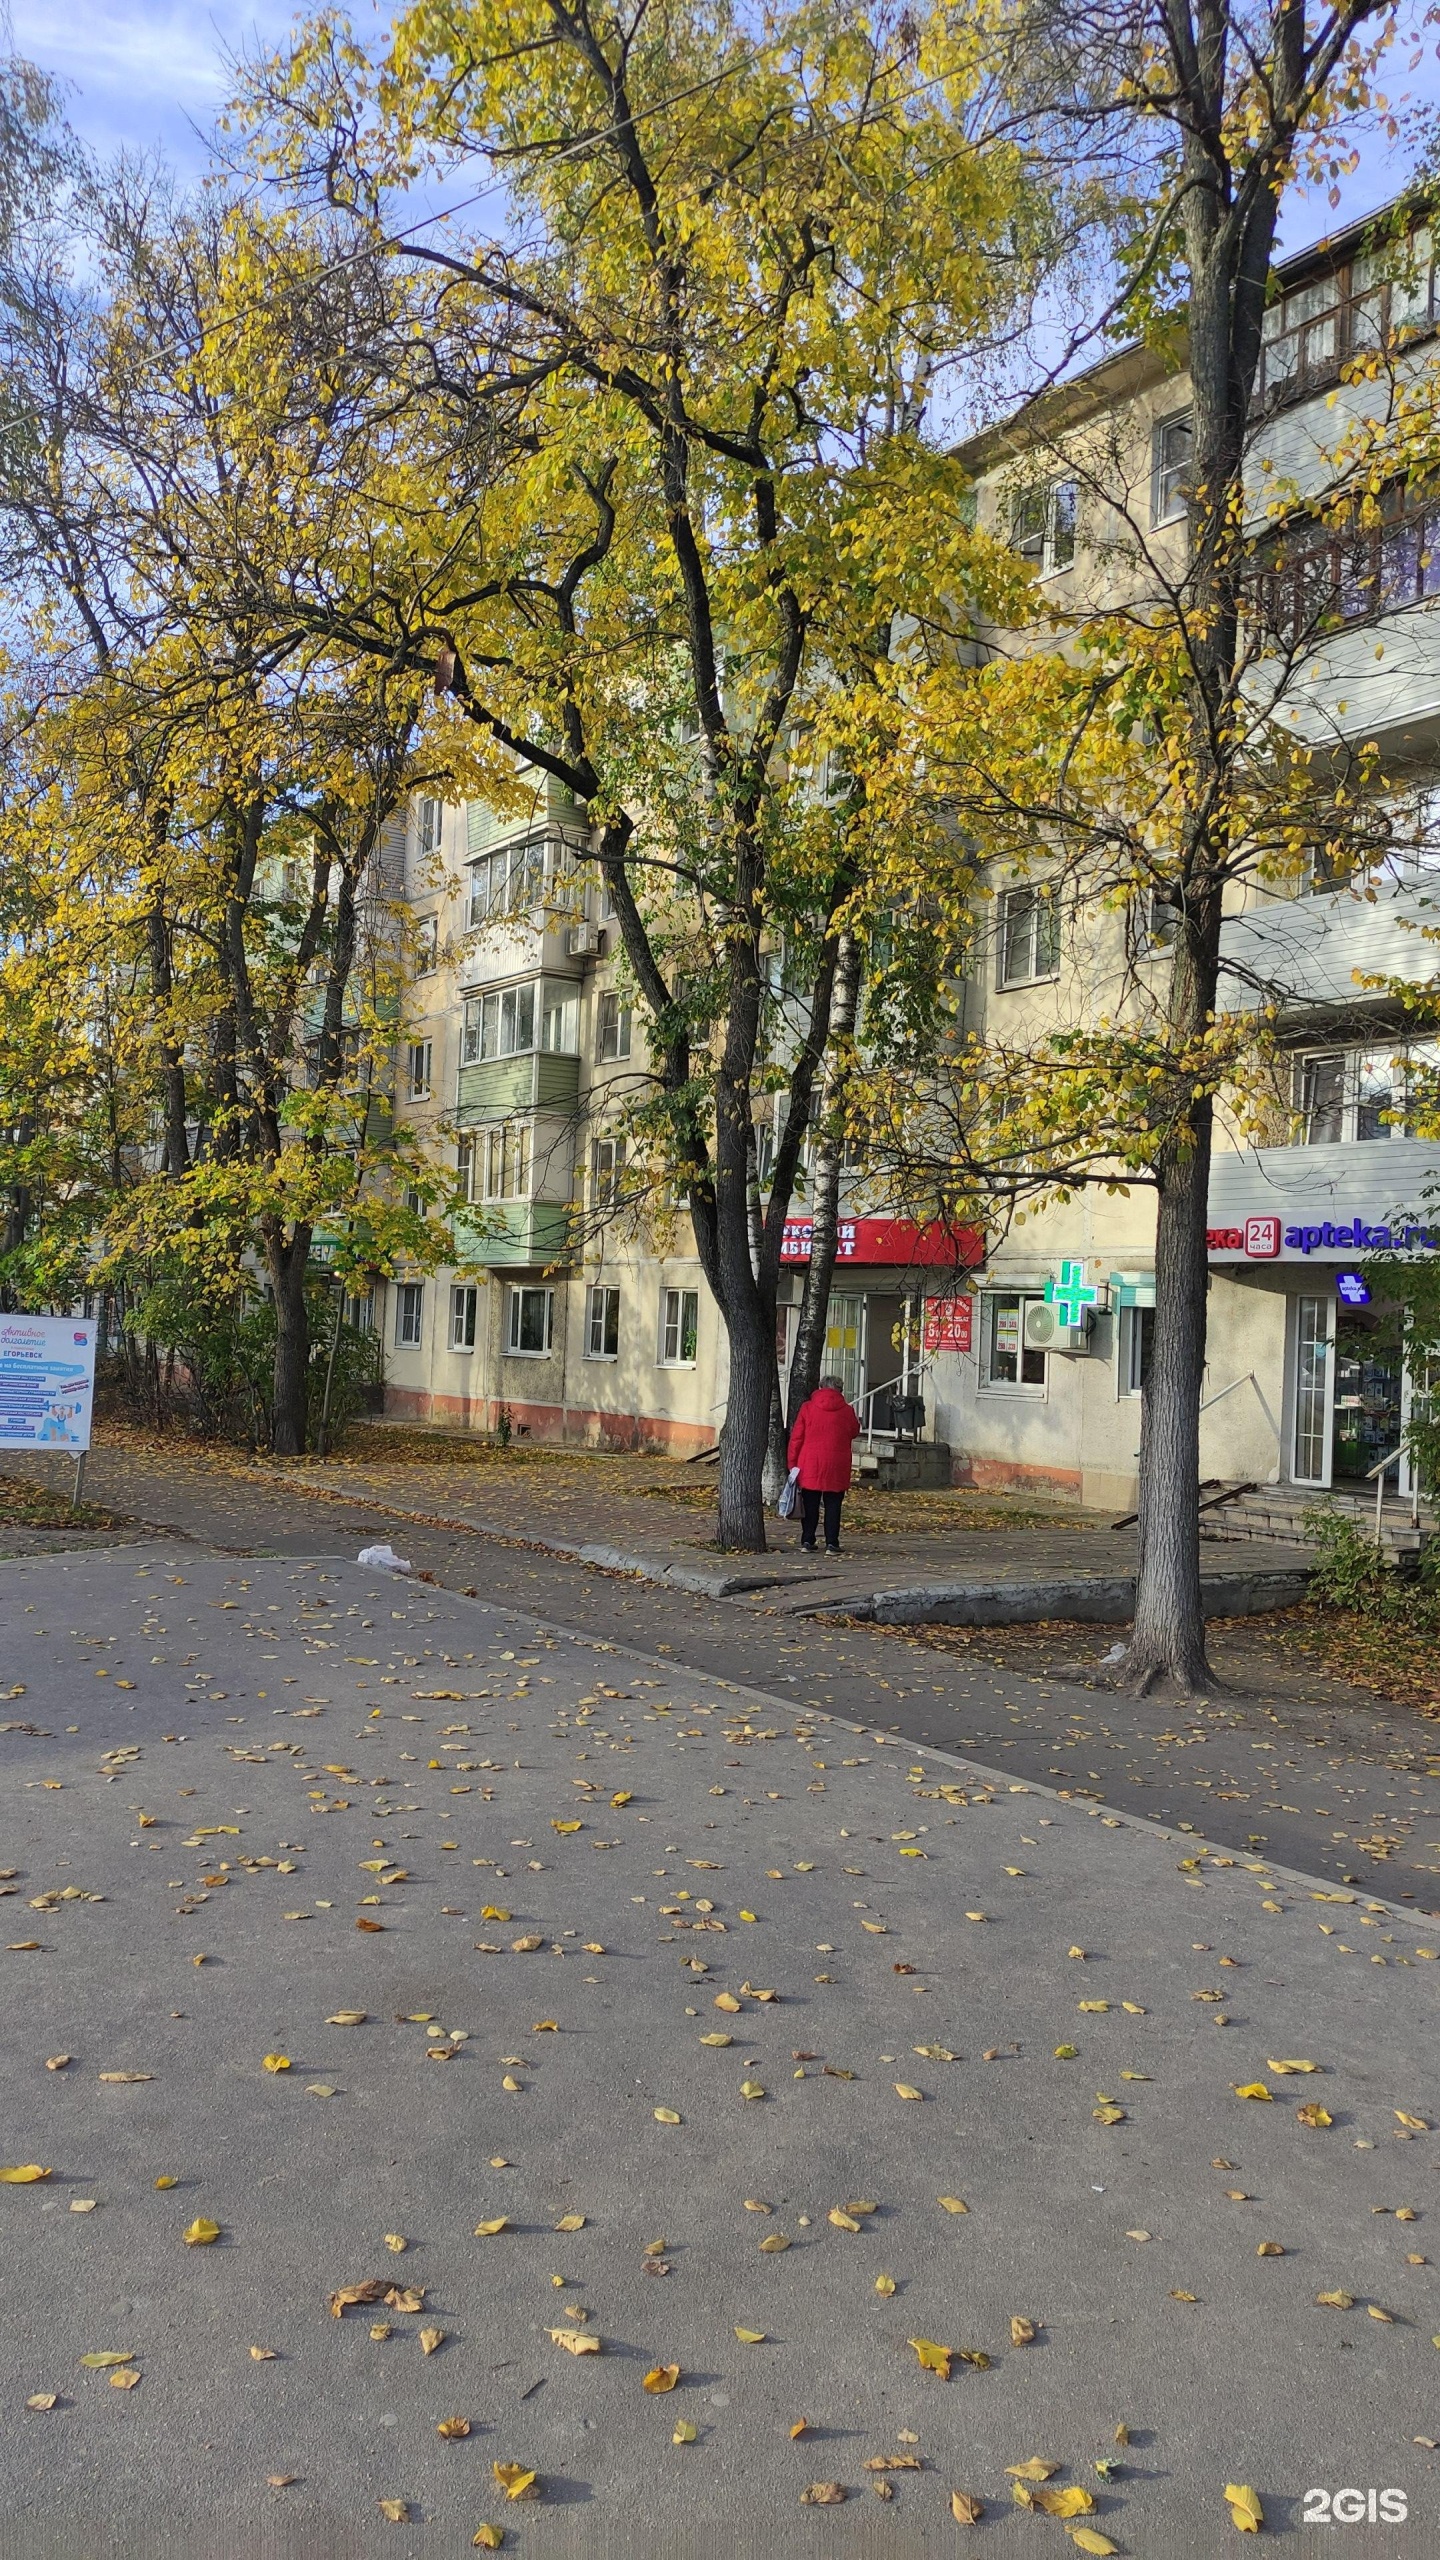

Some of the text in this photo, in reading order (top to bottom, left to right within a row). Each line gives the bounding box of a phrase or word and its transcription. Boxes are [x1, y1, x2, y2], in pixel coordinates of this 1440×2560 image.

[1249, 1224, 1272, 1241] 24
[1, 1325, 46, 1338] Активное
[3, 1350, 43, 1359] ЕГОРЬЕВСК
